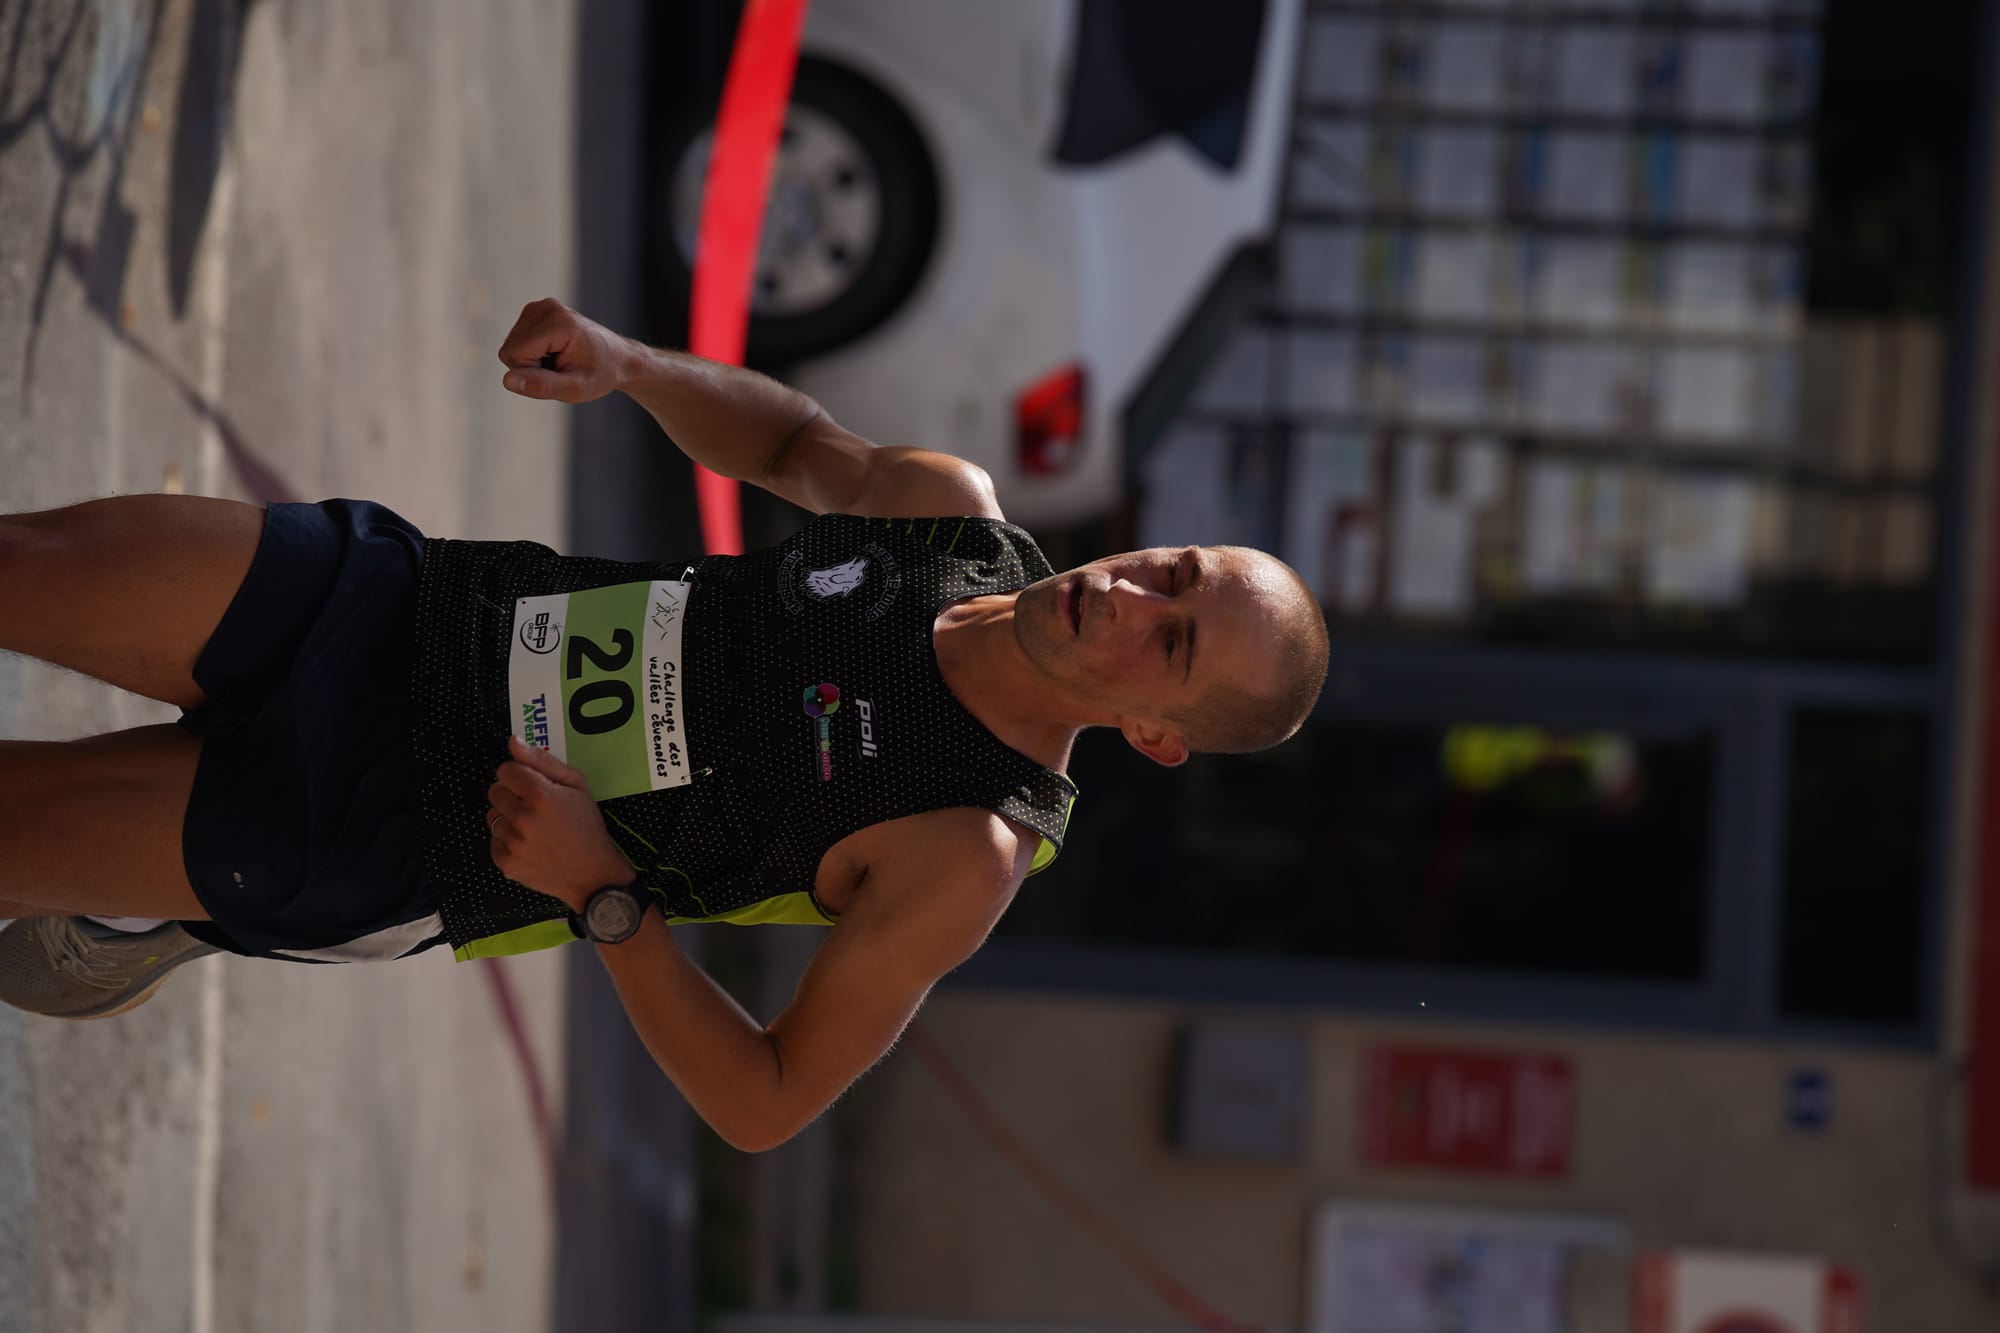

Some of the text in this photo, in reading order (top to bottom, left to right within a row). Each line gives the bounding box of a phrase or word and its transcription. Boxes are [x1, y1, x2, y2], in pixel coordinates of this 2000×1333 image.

[526, 622, 534, 640] GROUP
[532, 612, 550, 649] BFP
[567, 628, 635, 735] 20
[649, 656, 668, 778] vallées cévenoles
[661, 662, 681, 767] Challenge des
[855, 698, 878, 758] poli
